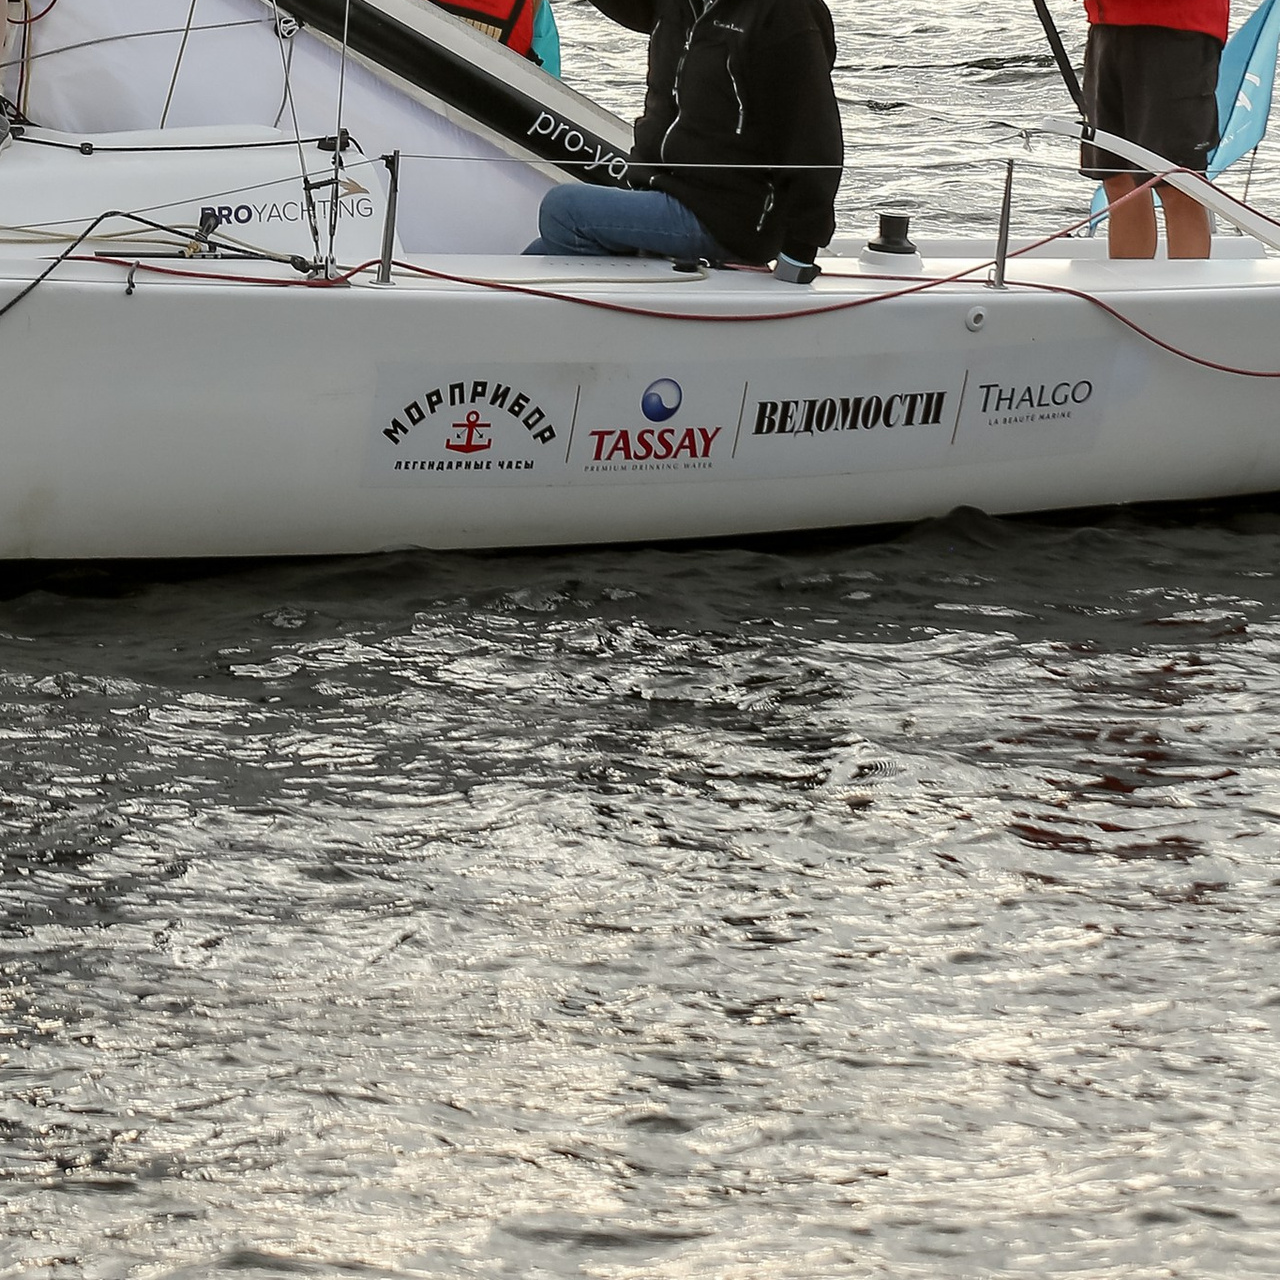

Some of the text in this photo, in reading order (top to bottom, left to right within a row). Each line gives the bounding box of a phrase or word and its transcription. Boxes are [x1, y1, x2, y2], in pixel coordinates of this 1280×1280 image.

[527, 111, 634, 191] pro-ya
[382, 381, 557, 445] МОРПРИБОР
[752, 391, 948, 437] ВЕДОМОСТИ
[979, 380, 1093, 413] THALGO
[988, 418, 999, 426] LA
[1038, 411, 1072, 421] MARINE
[589, 426, 722, 461] TASSAY
[394, 460, 535, 471] ЛЕГЕНДАРНЫЕ ЧАСЫ
